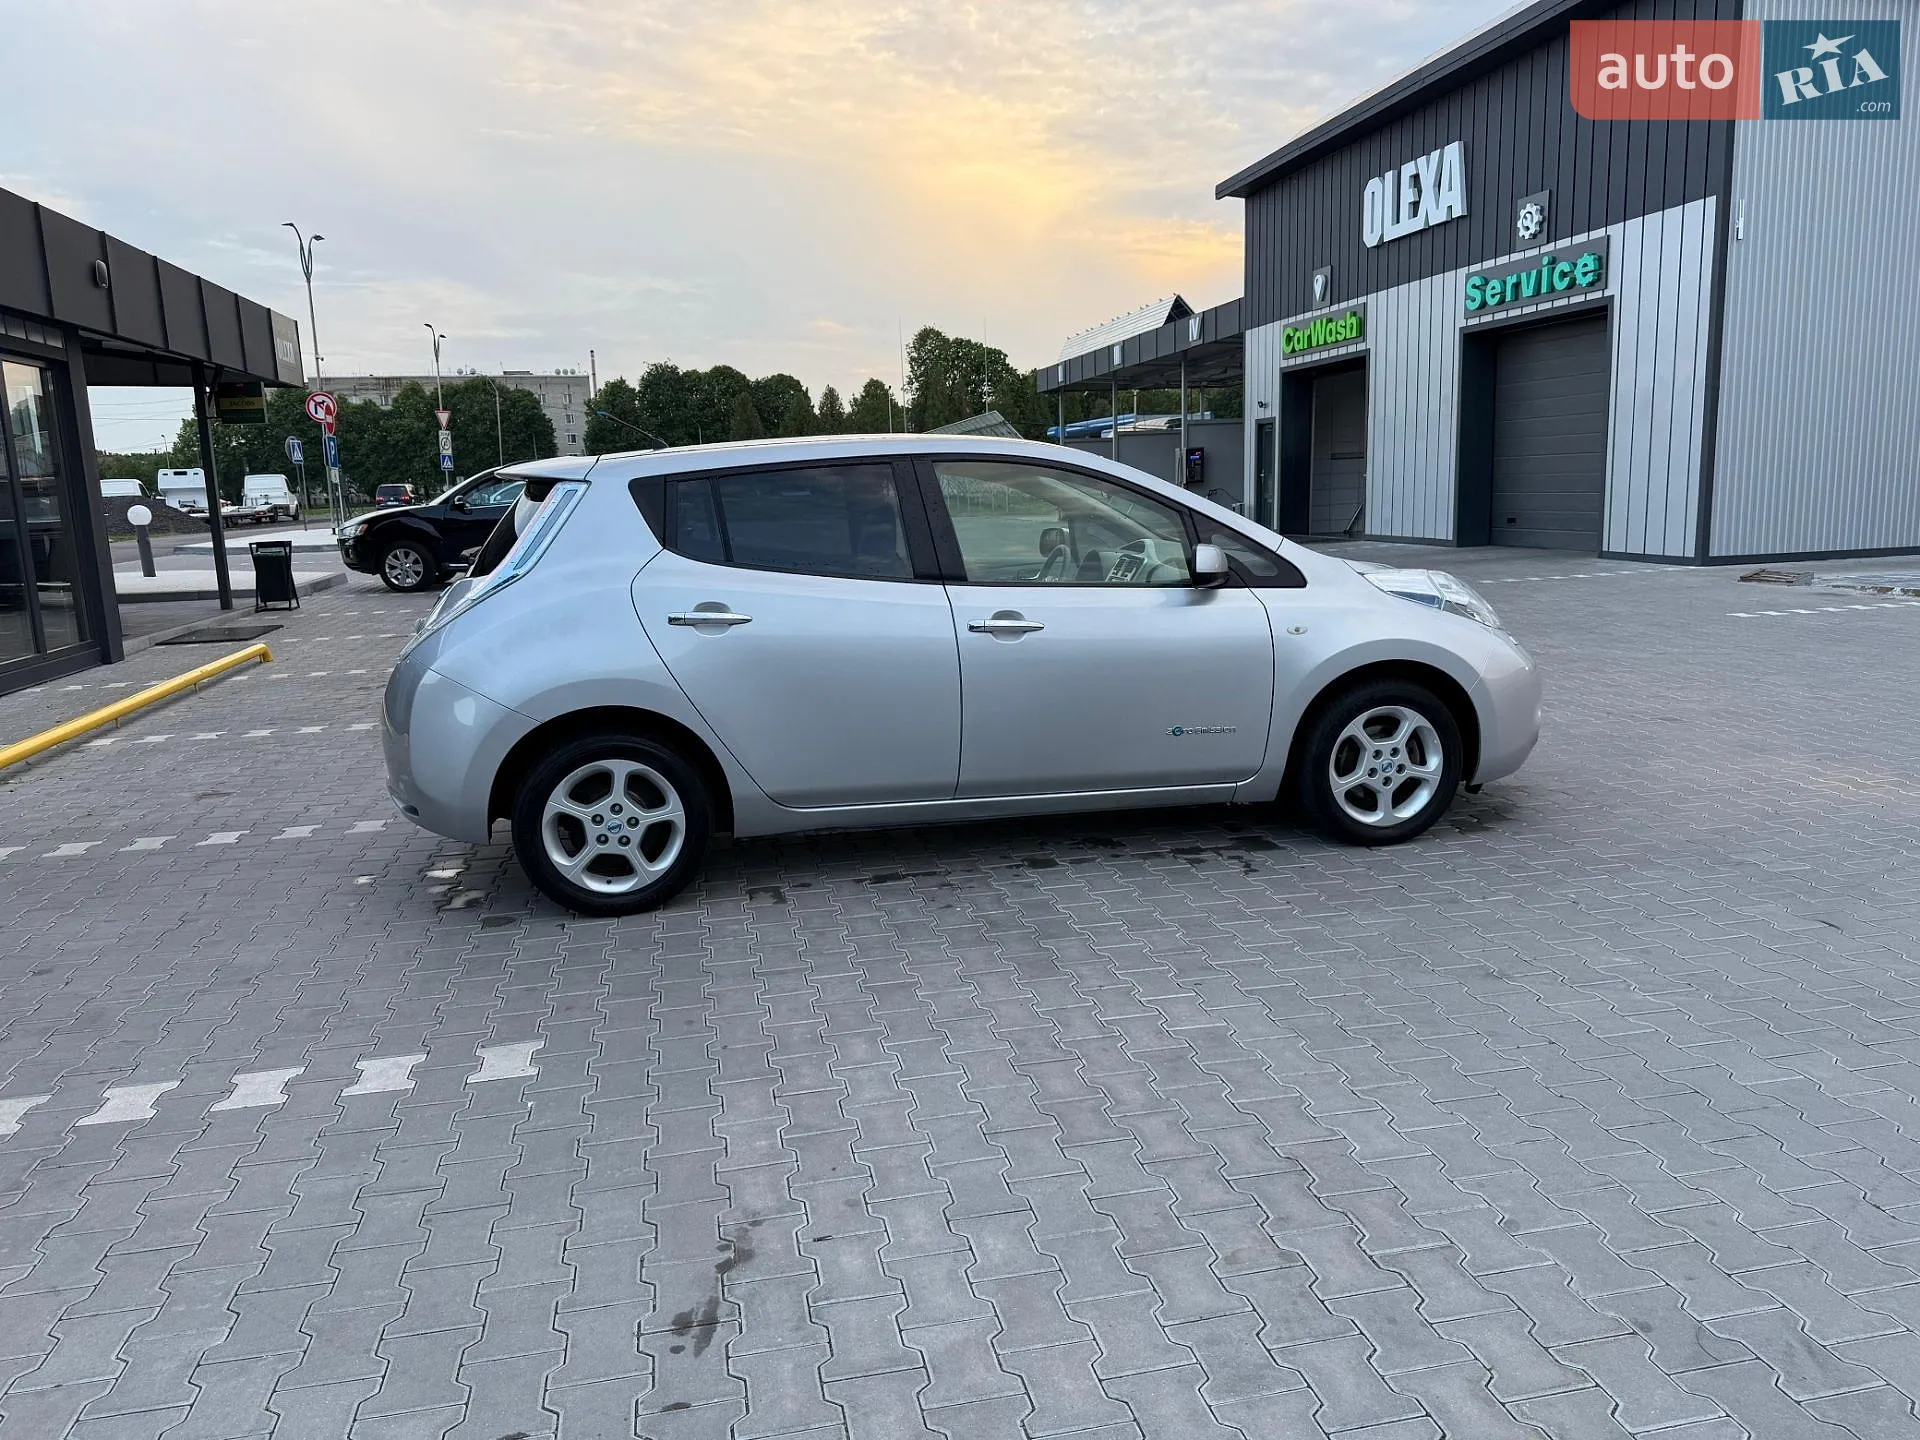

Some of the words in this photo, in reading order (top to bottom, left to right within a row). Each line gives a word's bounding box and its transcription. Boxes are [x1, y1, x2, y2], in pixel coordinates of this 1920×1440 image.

[1363, 140, 1468, 248] OLEXA
[1465, 252, 1602, 312] Service
[1282, 310, 1363, 354] CarWash
